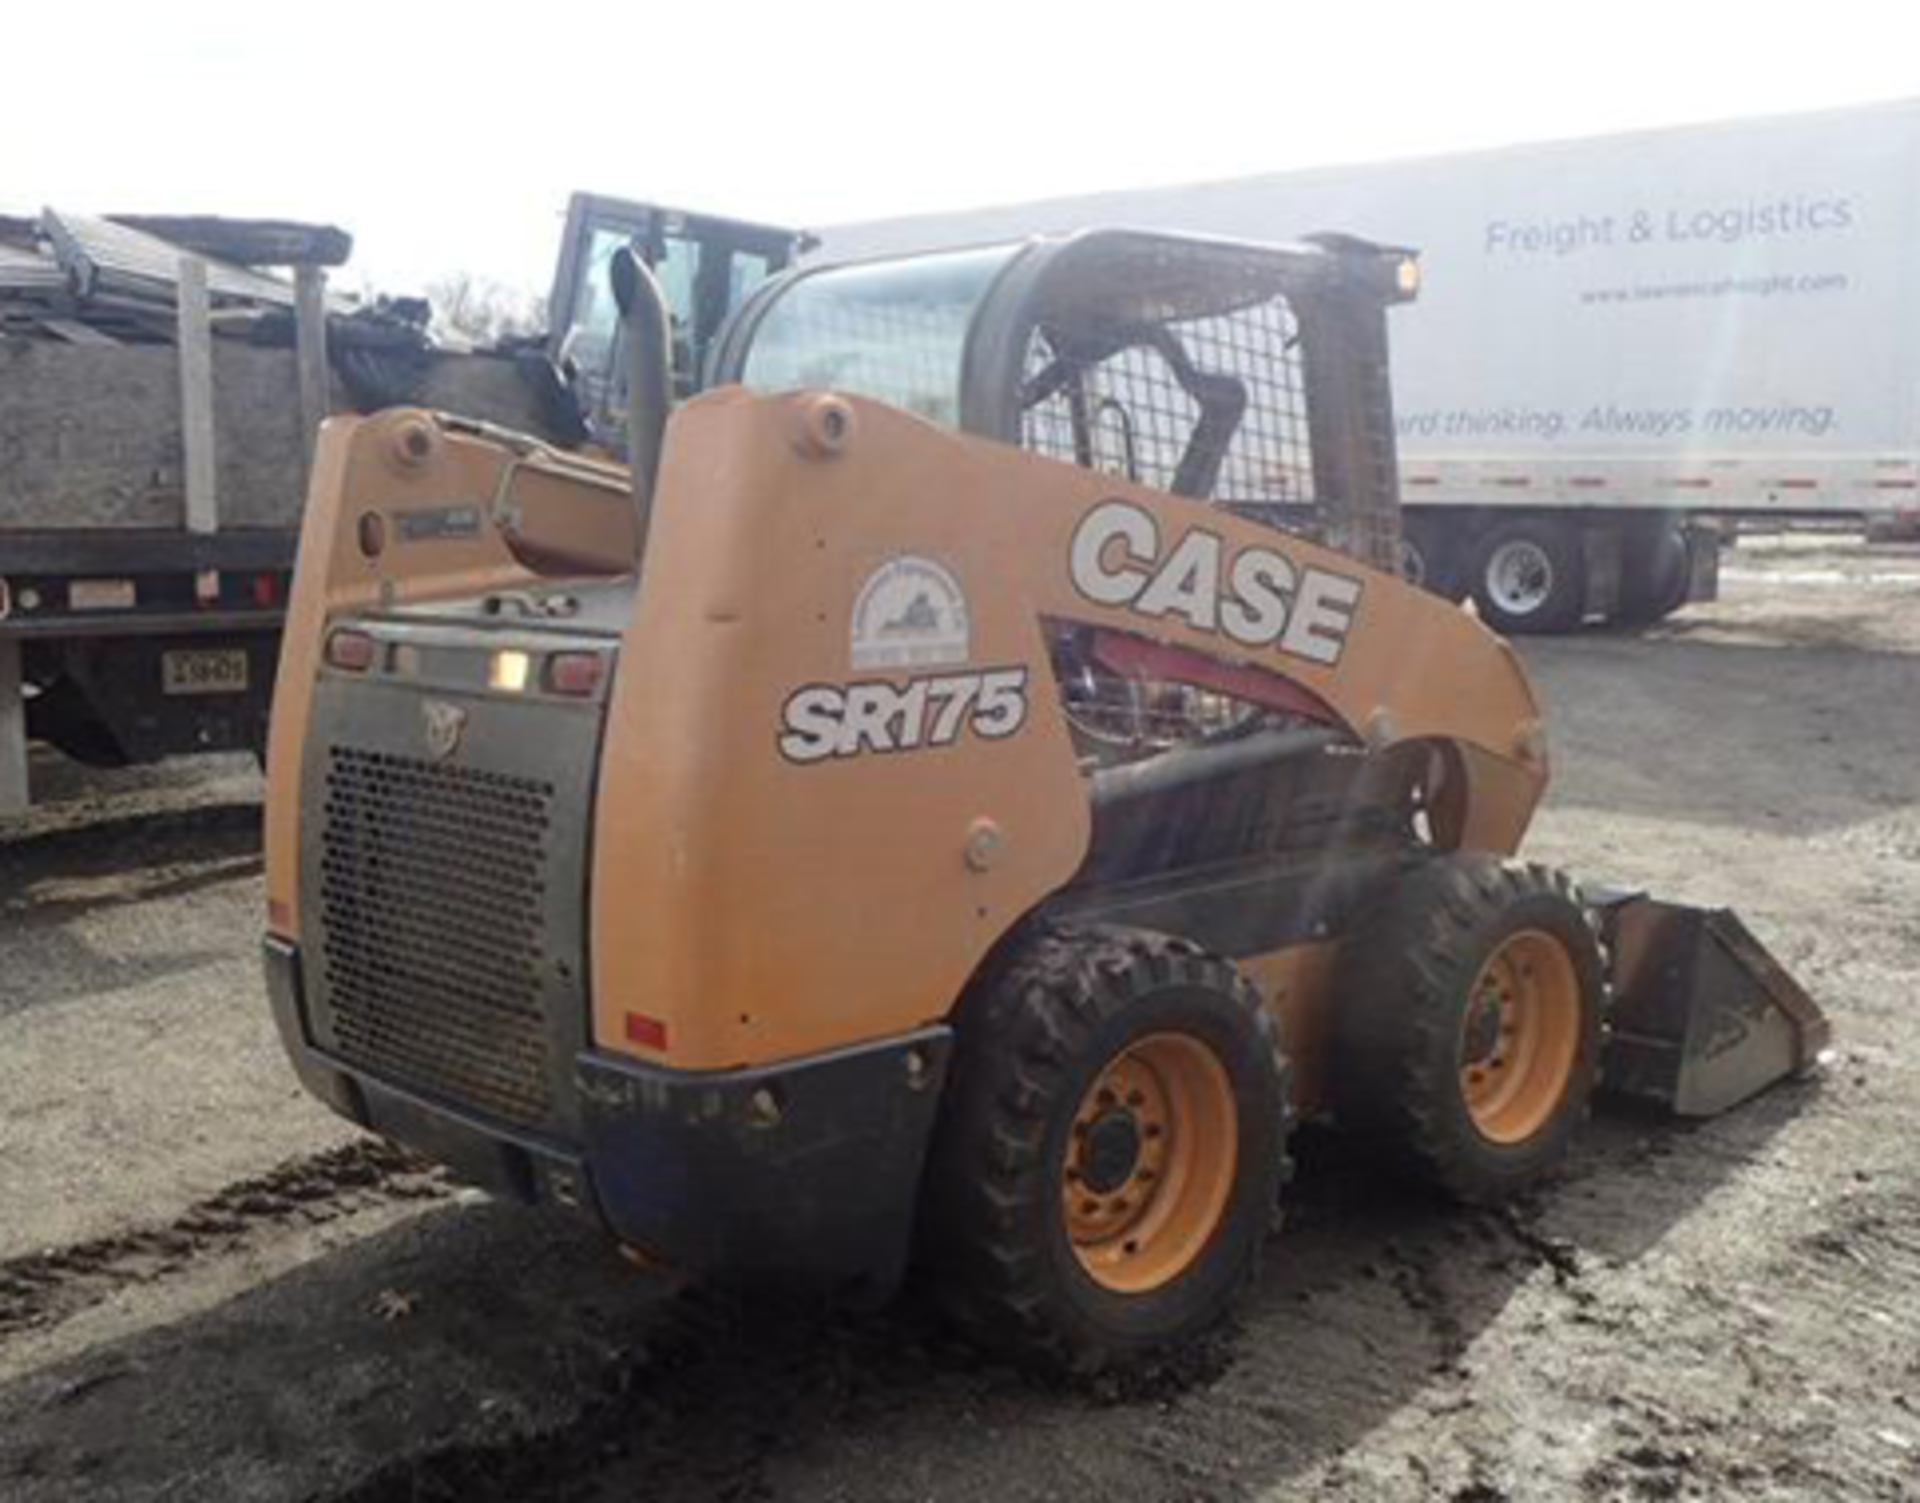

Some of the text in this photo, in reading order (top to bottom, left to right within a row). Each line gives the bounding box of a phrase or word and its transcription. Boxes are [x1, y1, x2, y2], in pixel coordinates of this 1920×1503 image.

[1486, 197, 1853, 255] Freight & Logistics
[1580, 404, 1693, 438] Always
[1705, 402, 1841, 437] moving.
[1069, 502, 1363, 666] CASE
[779, 666, 1027, 764] SR175
